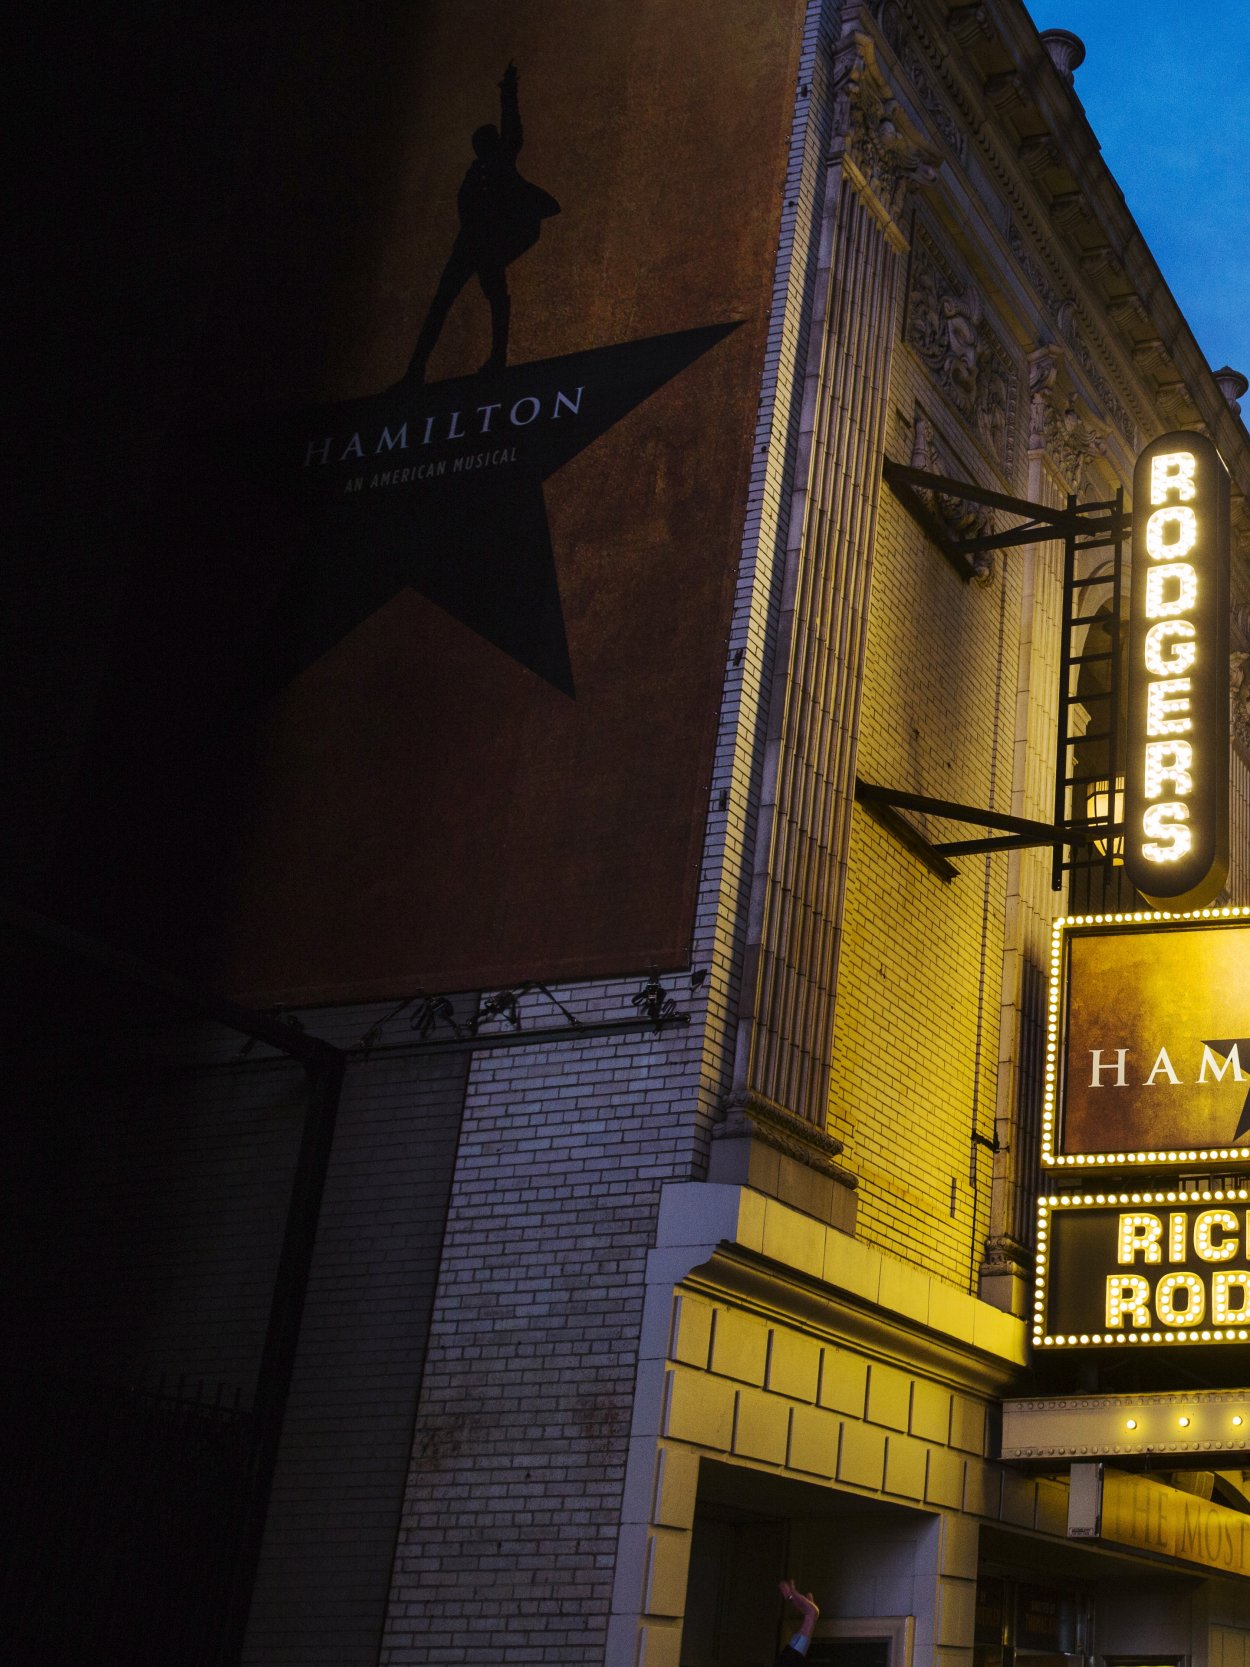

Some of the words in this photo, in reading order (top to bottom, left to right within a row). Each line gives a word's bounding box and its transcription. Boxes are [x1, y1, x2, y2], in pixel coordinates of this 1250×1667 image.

[304, 385, 585, 467] HAMILTON
[344, 479, 363, 493] AN
[370, 460, 446, 489] AMERICAN
[453, 447, 518, 473] MUSICAL
[1141, 451, 1198, 863] RODGERS
[1106, 1480, 1169, 1549] THE
[1180, 1500, 1248, 1570] MOST
